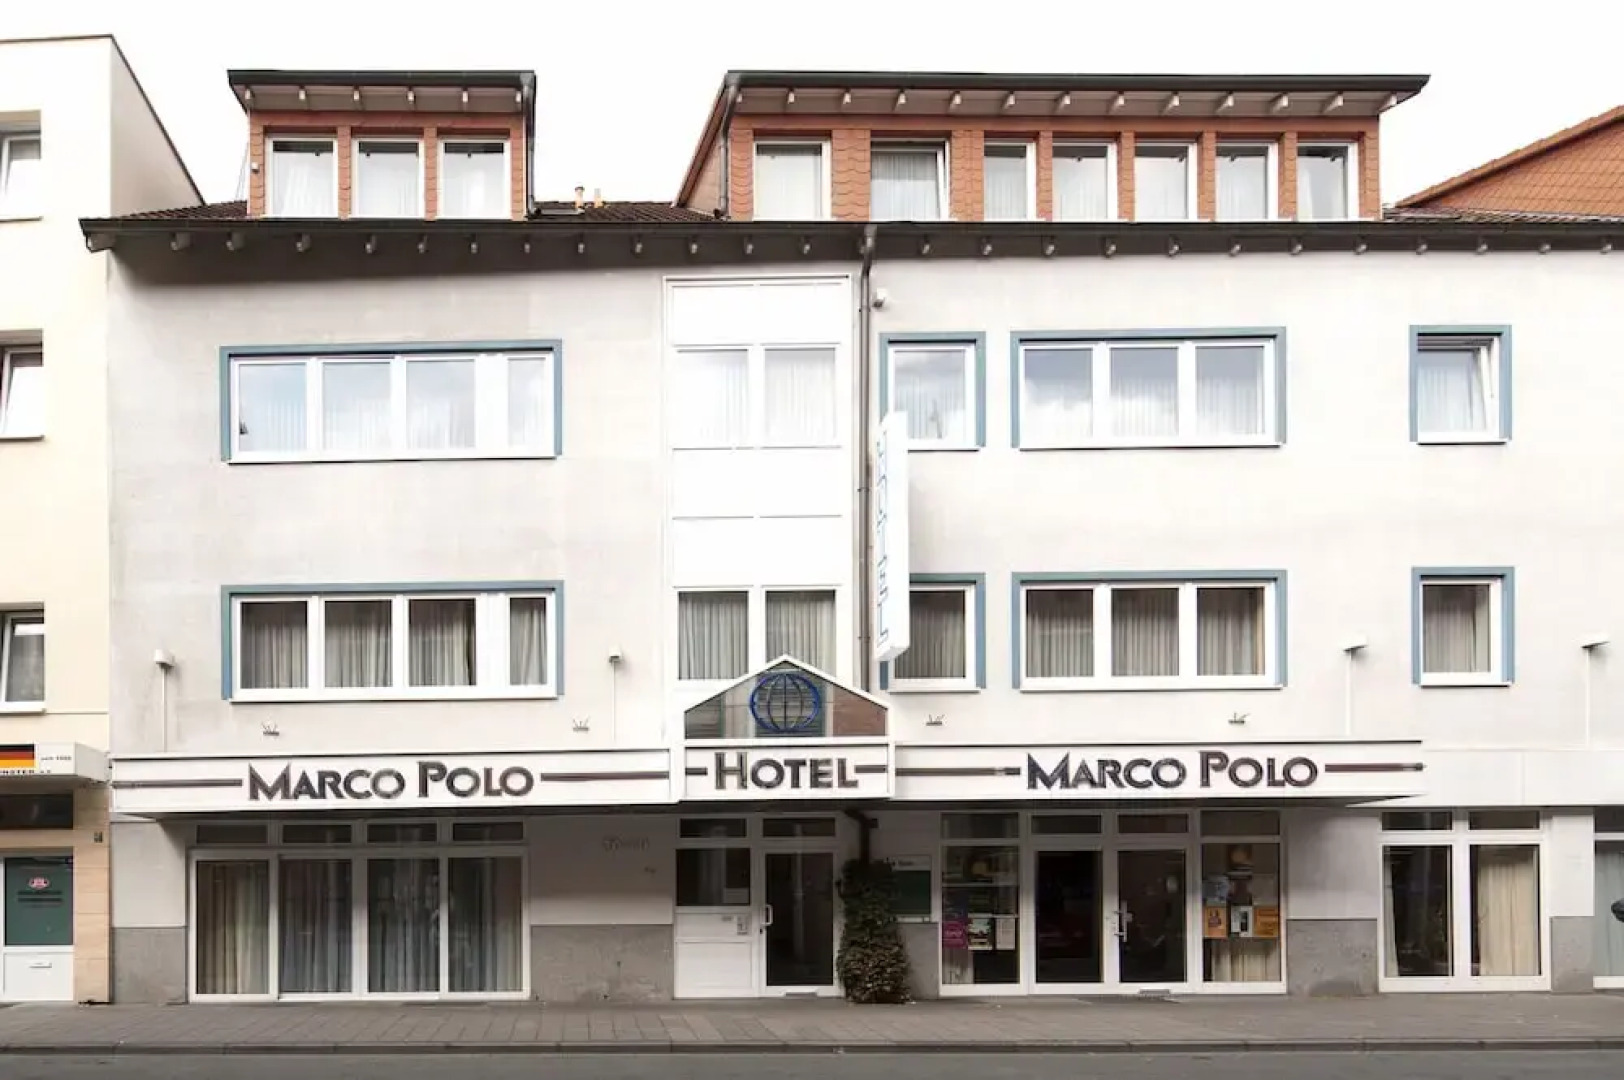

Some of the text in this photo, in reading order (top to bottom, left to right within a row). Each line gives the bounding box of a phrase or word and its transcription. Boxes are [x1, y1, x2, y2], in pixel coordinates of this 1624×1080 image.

[248, 760, 535, 801] MARCO POLO
[714, 752, 858, 790] HOTEL
[1027, 750, 1319, 790] MARCO POLO
